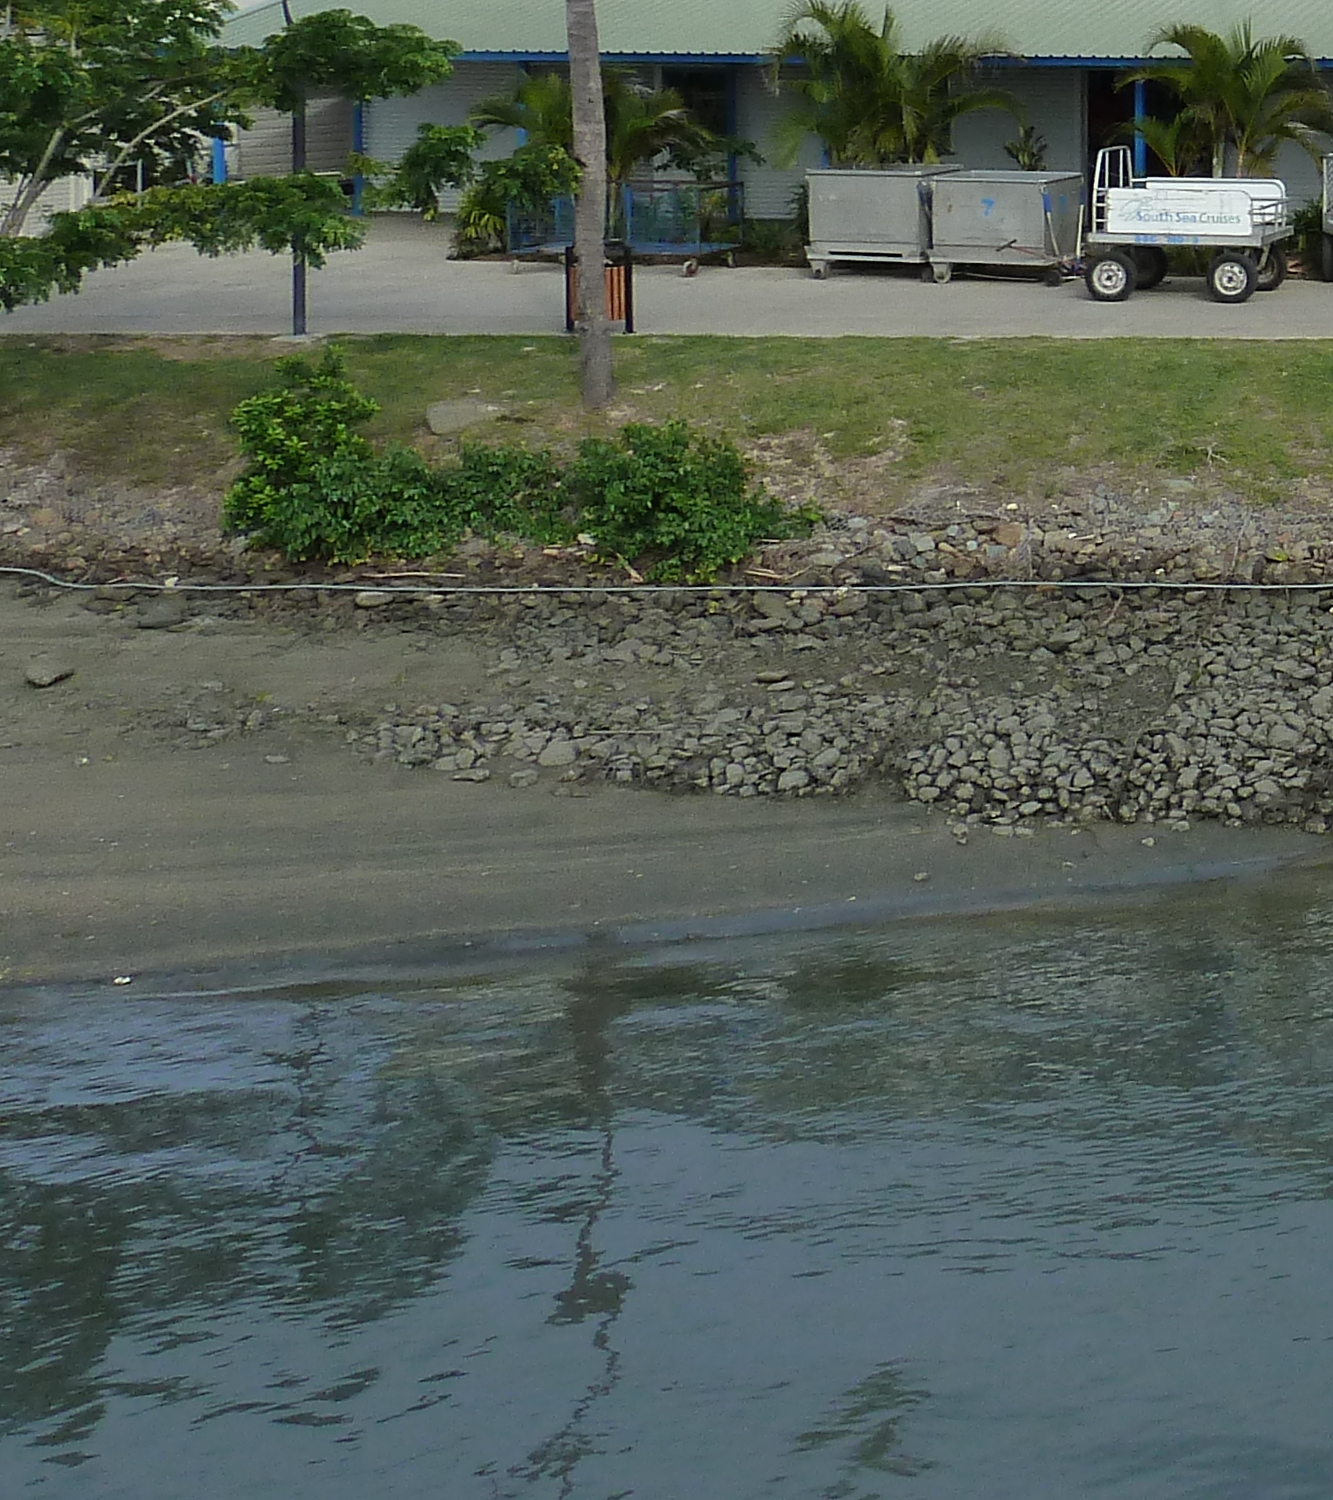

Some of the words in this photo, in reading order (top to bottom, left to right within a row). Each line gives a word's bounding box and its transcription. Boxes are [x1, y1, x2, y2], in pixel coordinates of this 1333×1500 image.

[1136, 211, 1173, 223] South
[1175, 211, 1197, 223] Sea
[1199, 212, 1241, 224] Cruises
